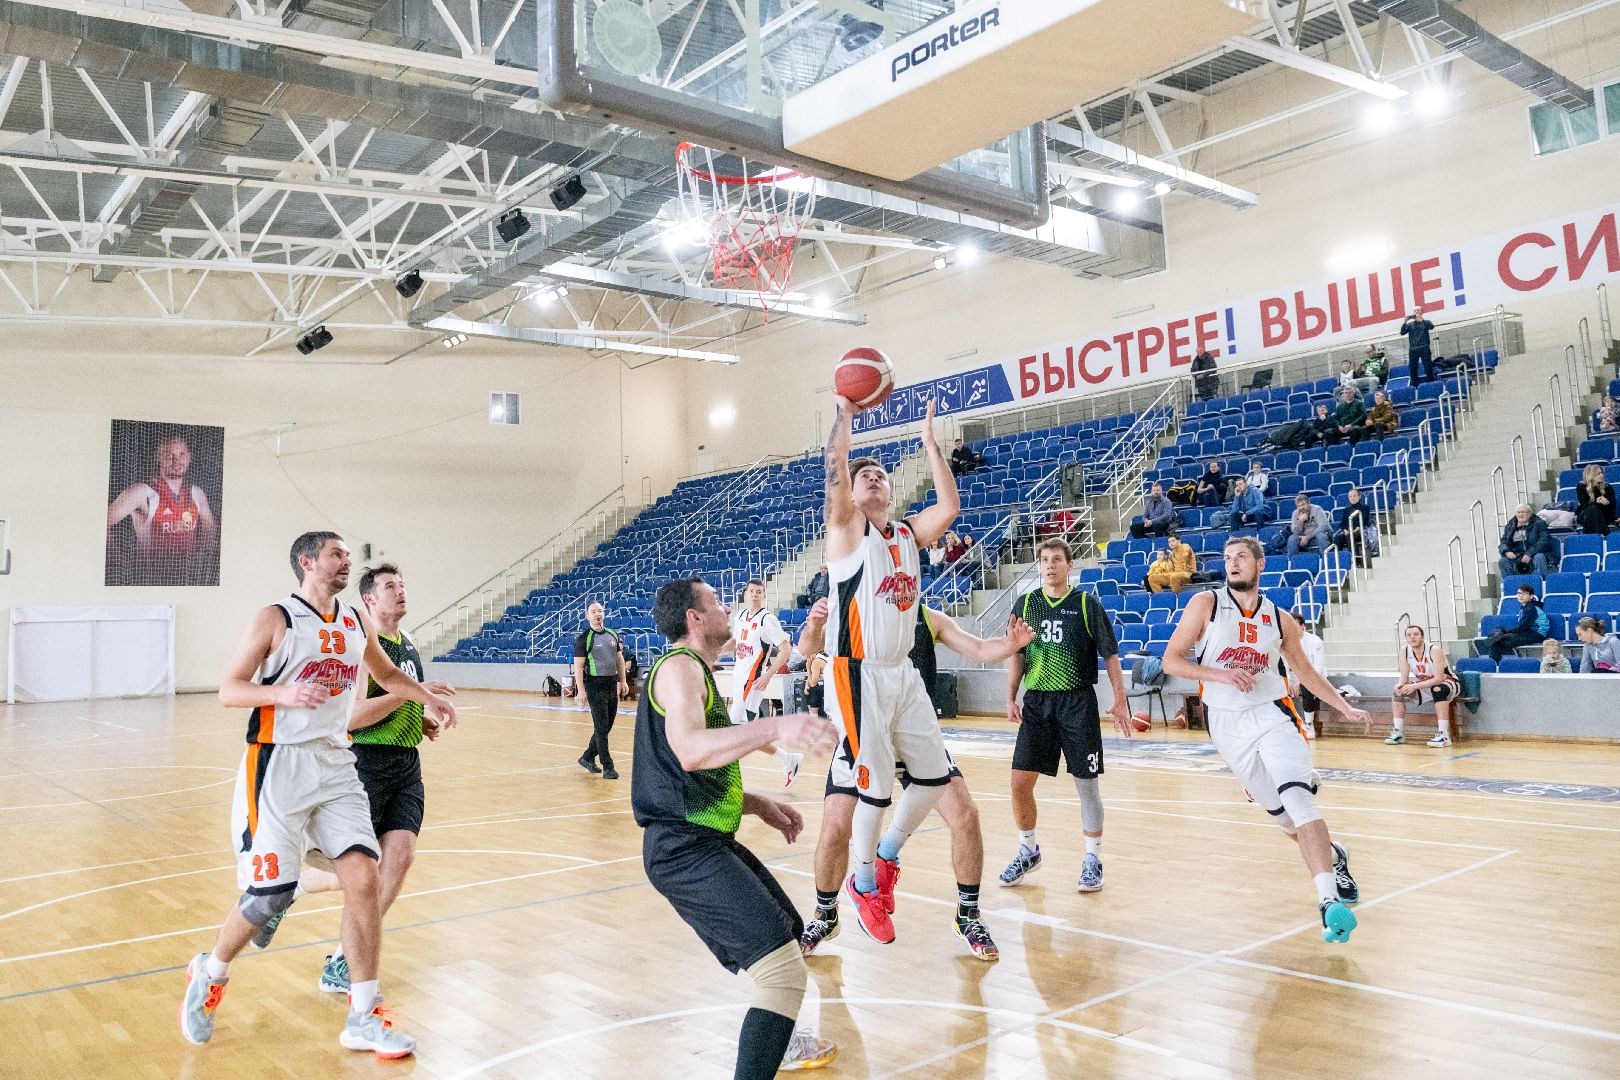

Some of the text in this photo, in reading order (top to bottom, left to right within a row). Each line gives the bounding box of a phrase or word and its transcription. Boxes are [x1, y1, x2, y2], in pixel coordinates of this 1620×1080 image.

[1019, 307, 1237, 399] БЫСТРЕЕ!
[1259, 251, 1467, 348] ВЫШЕ!
[319, 629, 347, 654] 23
[1041, 619, 1063, 643] 35
[1239, 622, 1257, 643] 15
[252, 852, 279, 881] 23
